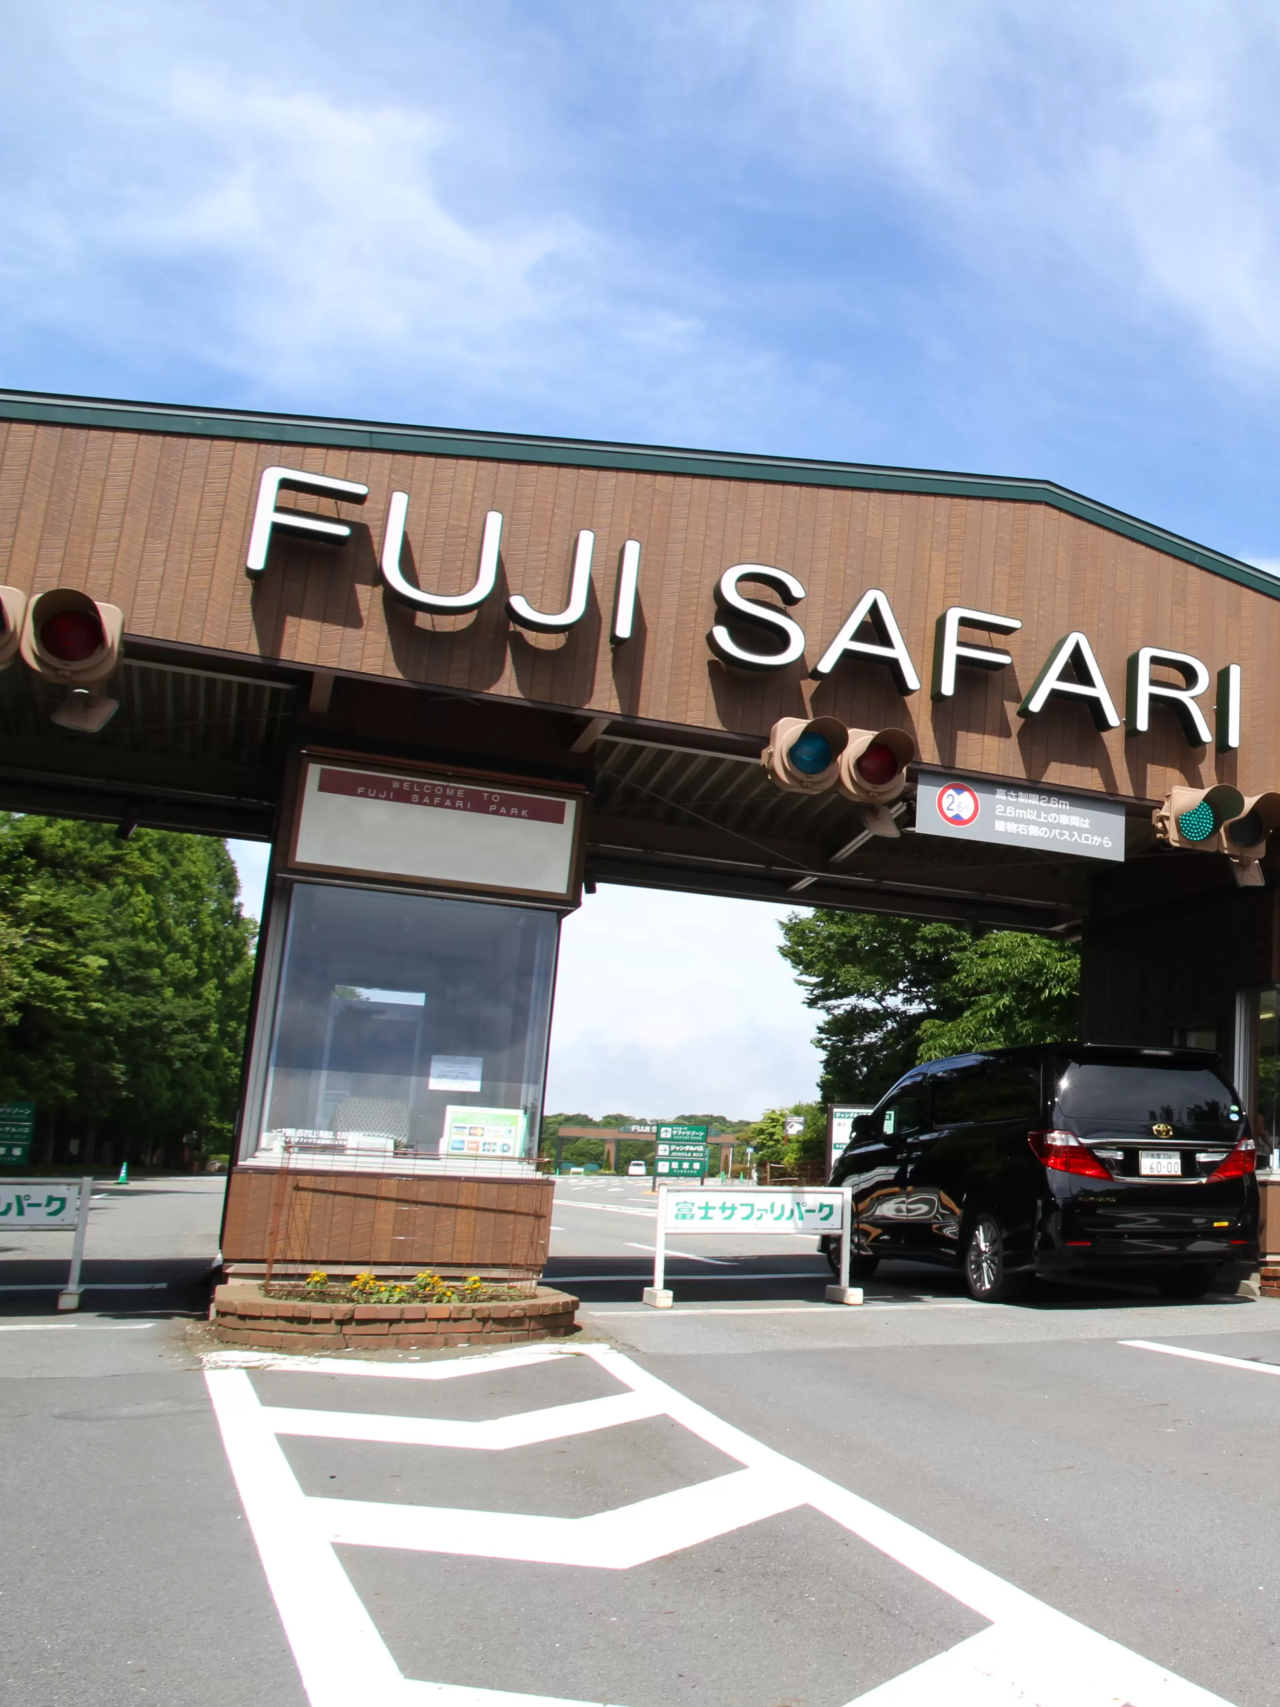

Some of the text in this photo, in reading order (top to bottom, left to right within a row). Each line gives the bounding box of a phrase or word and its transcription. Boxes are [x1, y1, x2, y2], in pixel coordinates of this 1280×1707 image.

[246, 465, 641, 642] FUJI
[707, 562, 1242, 750] SAFARI
[357, 787, 529, 818] FUJI SAFARI PARK
[392, 780, 500, 803] WELCOME TO
[995, 788, 1070, 810] 高さ制限2.6m
[995, 806, 1091, 829] 2.6m以上の車両は
[994, 819, 1113, 848] 建物右側のバス入口から
[631, 1125, 650, 1133] FUJI
[675, 1200, 834, 1221] 富士サファリパーク
